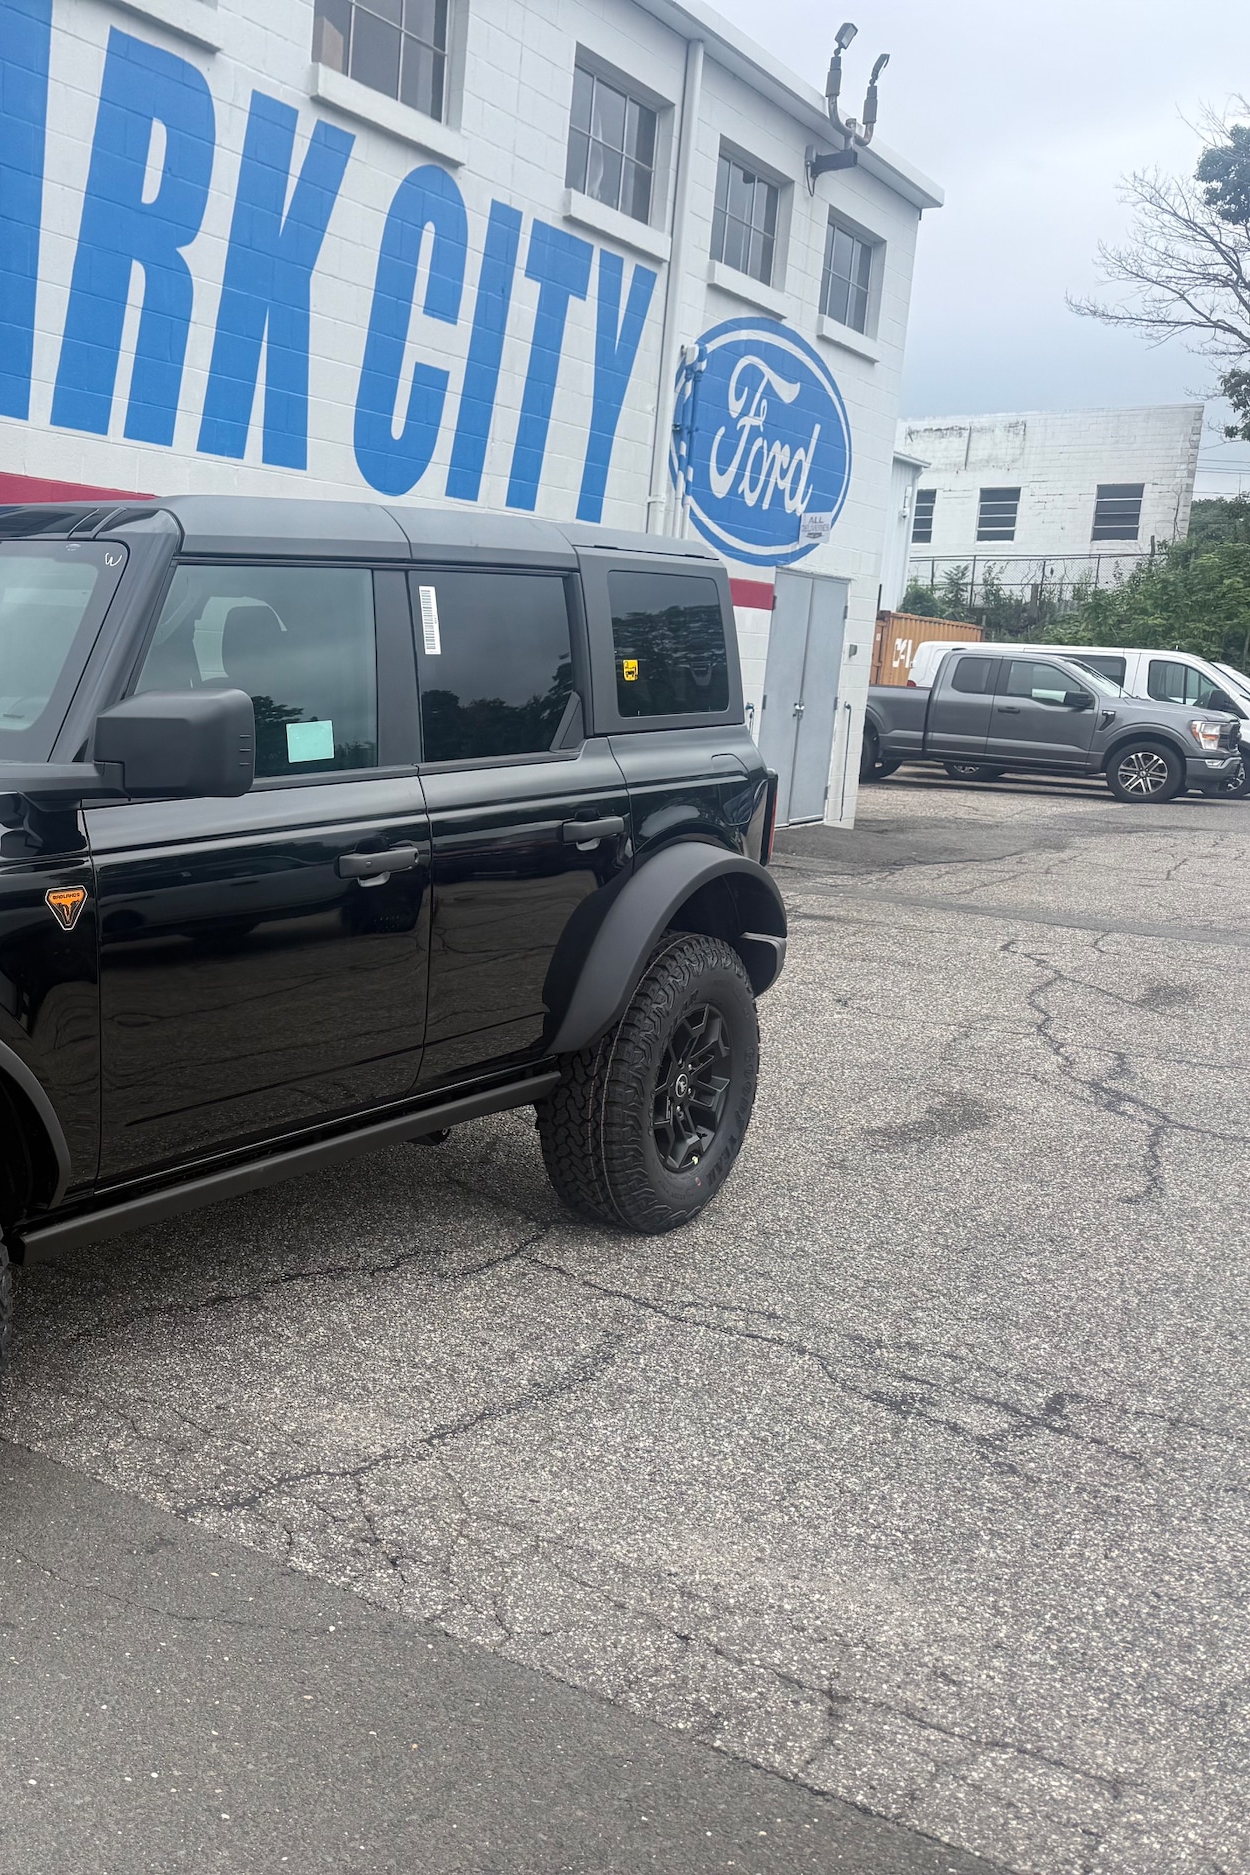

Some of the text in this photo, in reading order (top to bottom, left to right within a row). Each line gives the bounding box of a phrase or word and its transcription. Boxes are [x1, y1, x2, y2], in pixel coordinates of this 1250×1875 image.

[354, 164, 658, 524] CITY
[709, 354, 821, 517] Ford
[808, 515, 824, 524] ALL
